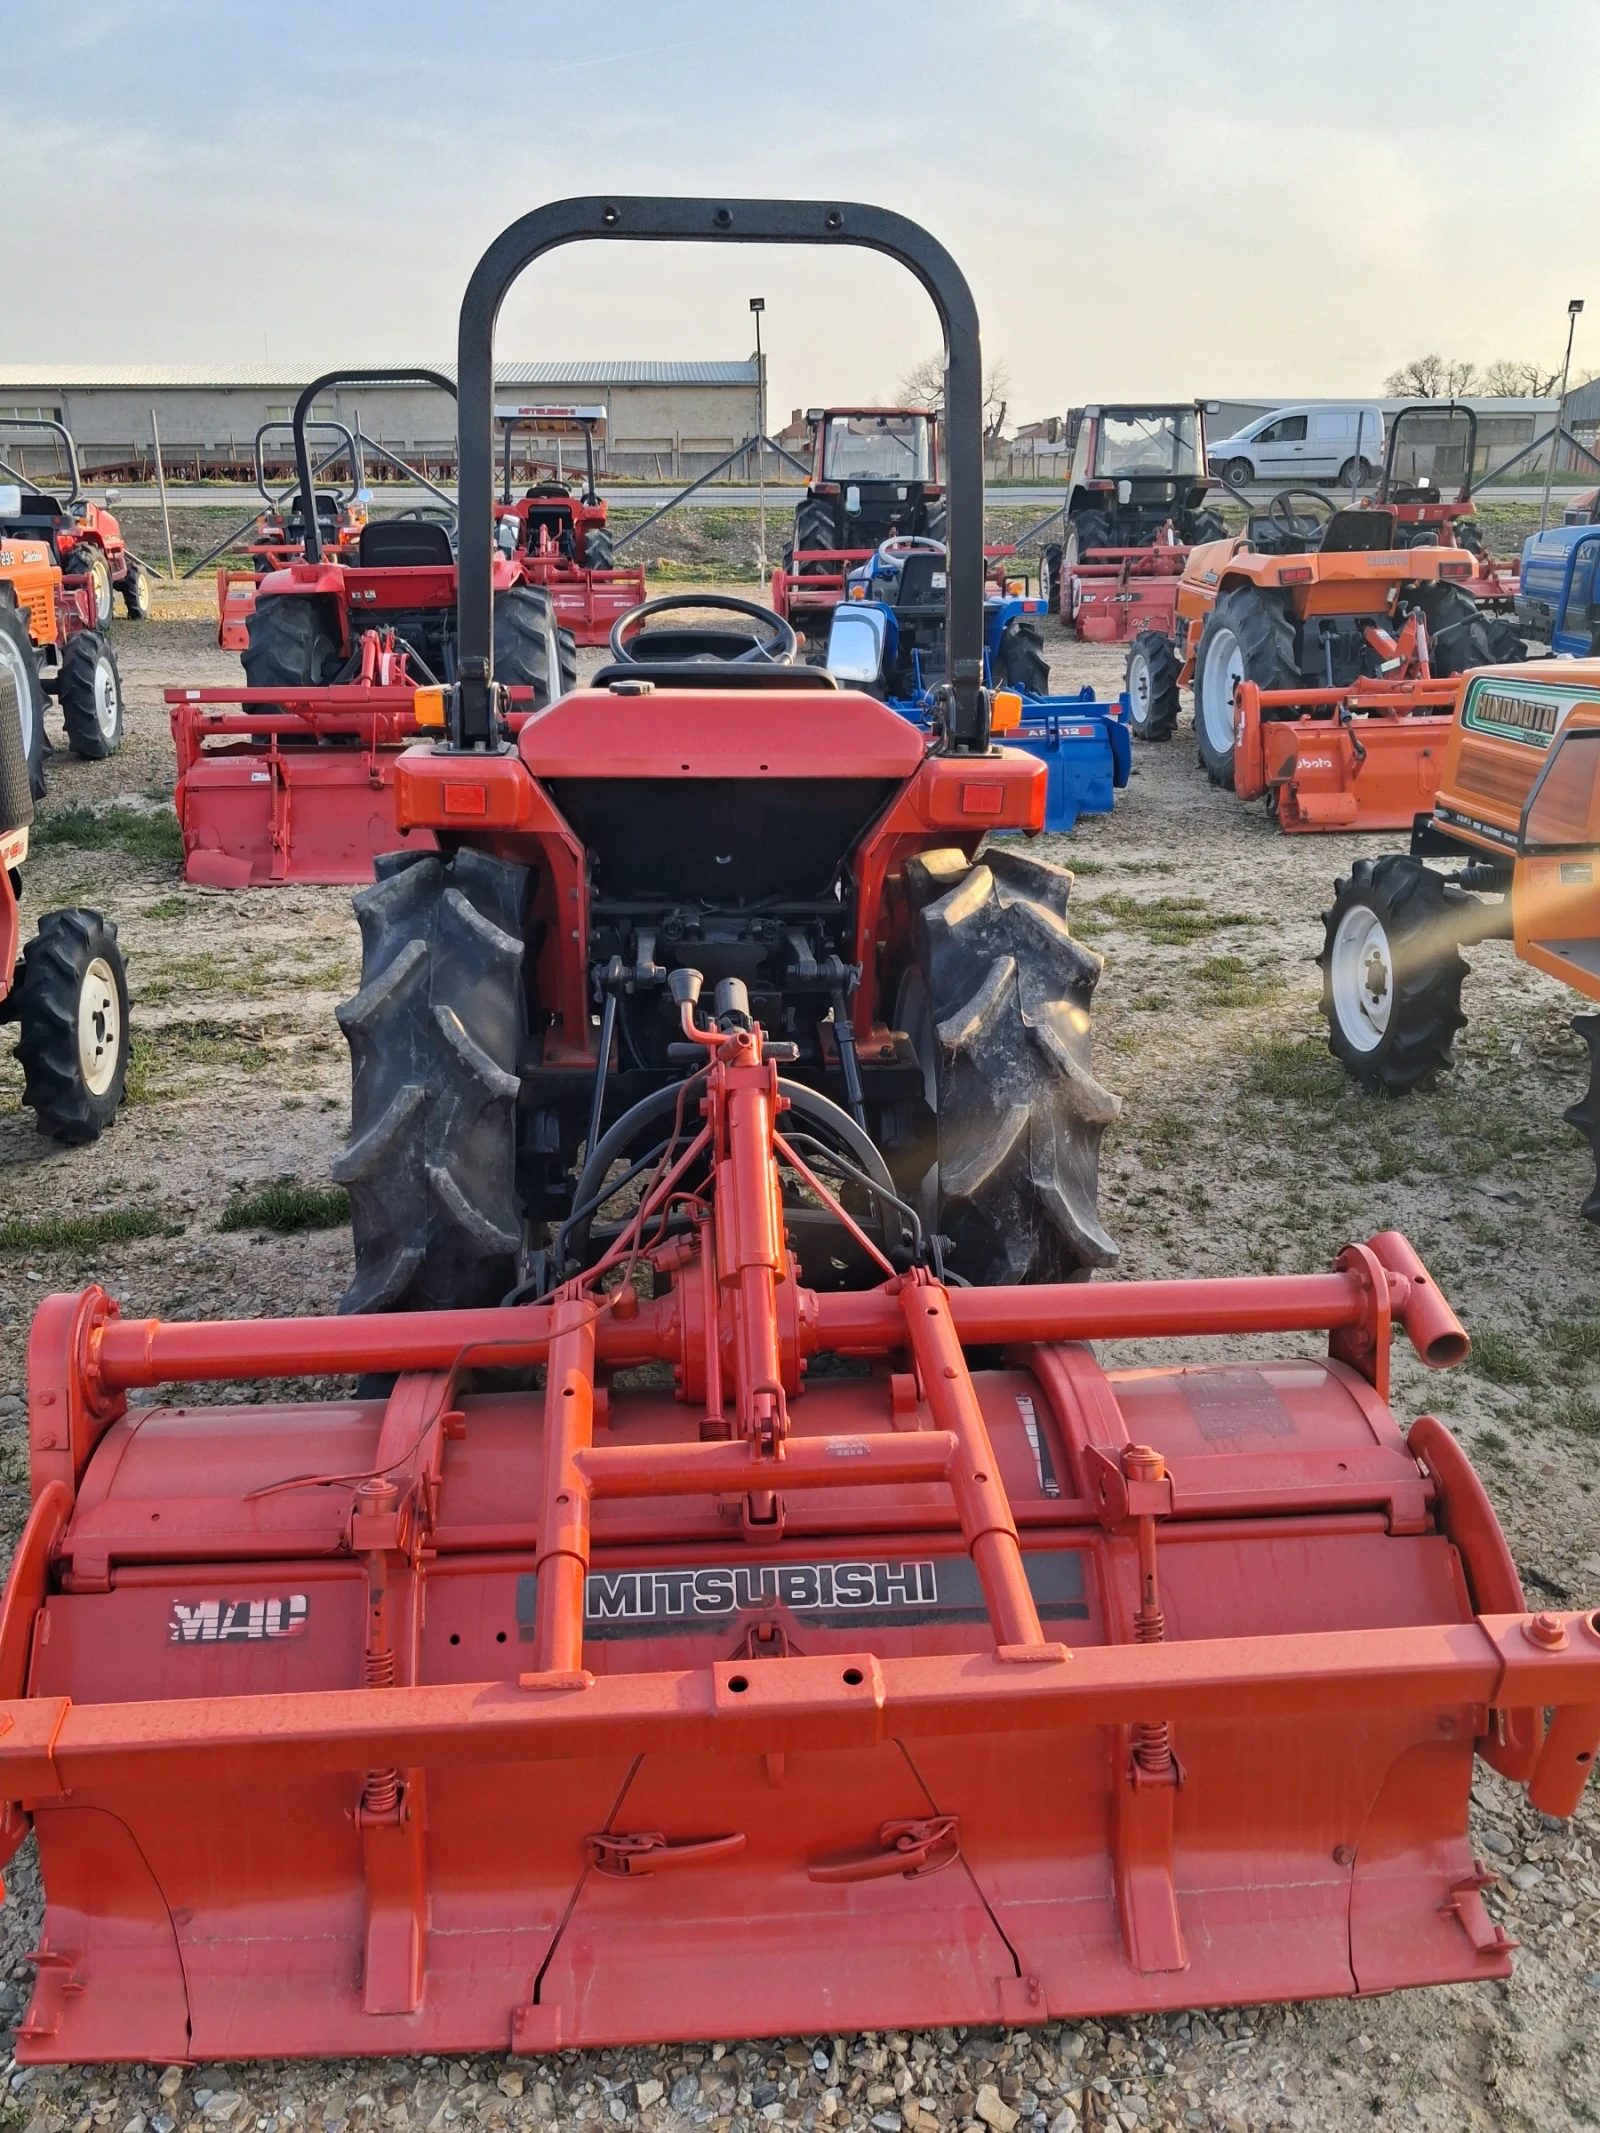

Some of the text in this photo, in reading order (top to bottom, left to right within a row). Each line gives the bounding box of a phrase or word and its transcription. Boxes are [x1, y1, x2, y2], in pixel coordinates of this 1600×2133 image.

[1563, 545, 1592, 559] ISKI
[1476, 693, 1557, 734] HINOMOTO
[1296, 757, 1332, 769] ubota
[585, 1561, 938, 1619] MITSUBISHI
